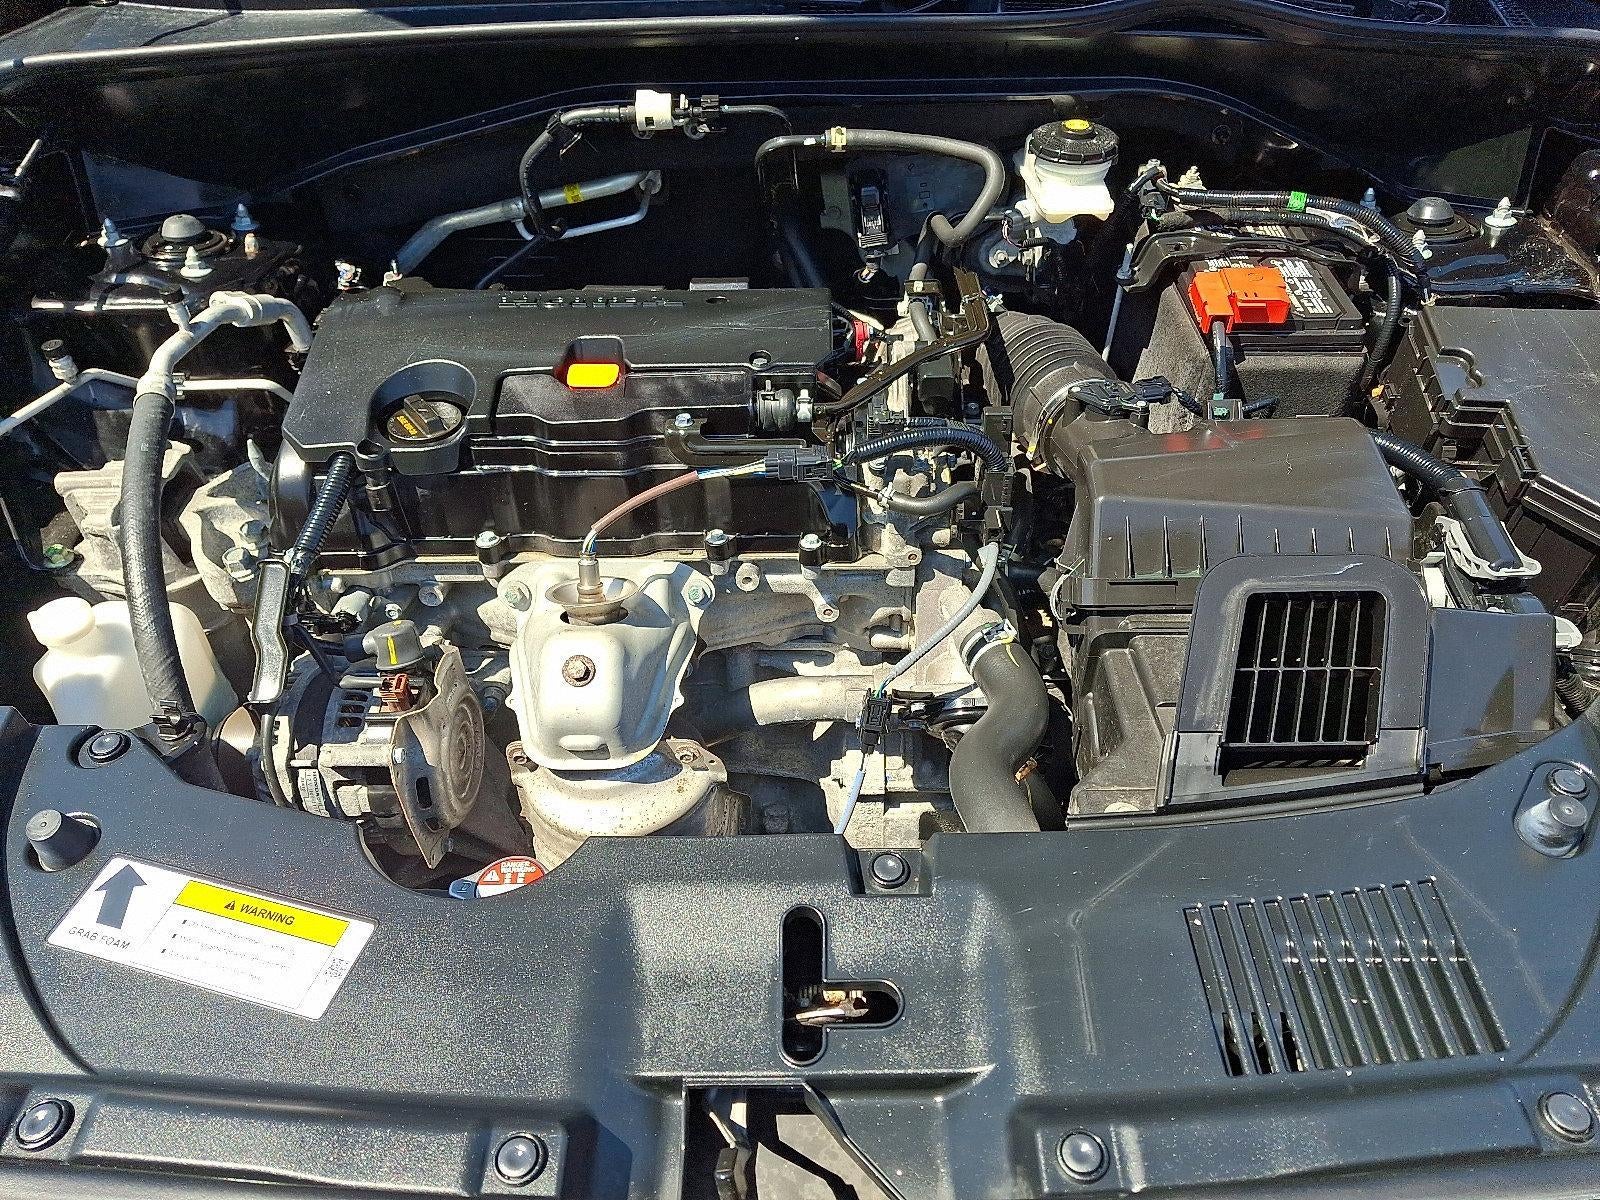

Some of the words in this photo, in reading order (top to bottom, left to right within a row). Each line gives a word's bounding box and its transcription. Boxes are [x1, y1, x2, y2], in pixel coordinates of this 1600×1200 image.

[239, 902, 295, 926] WARNING
[68, 926, 98, 944] GRAB
[100, 933, 131, 951] FOAM
